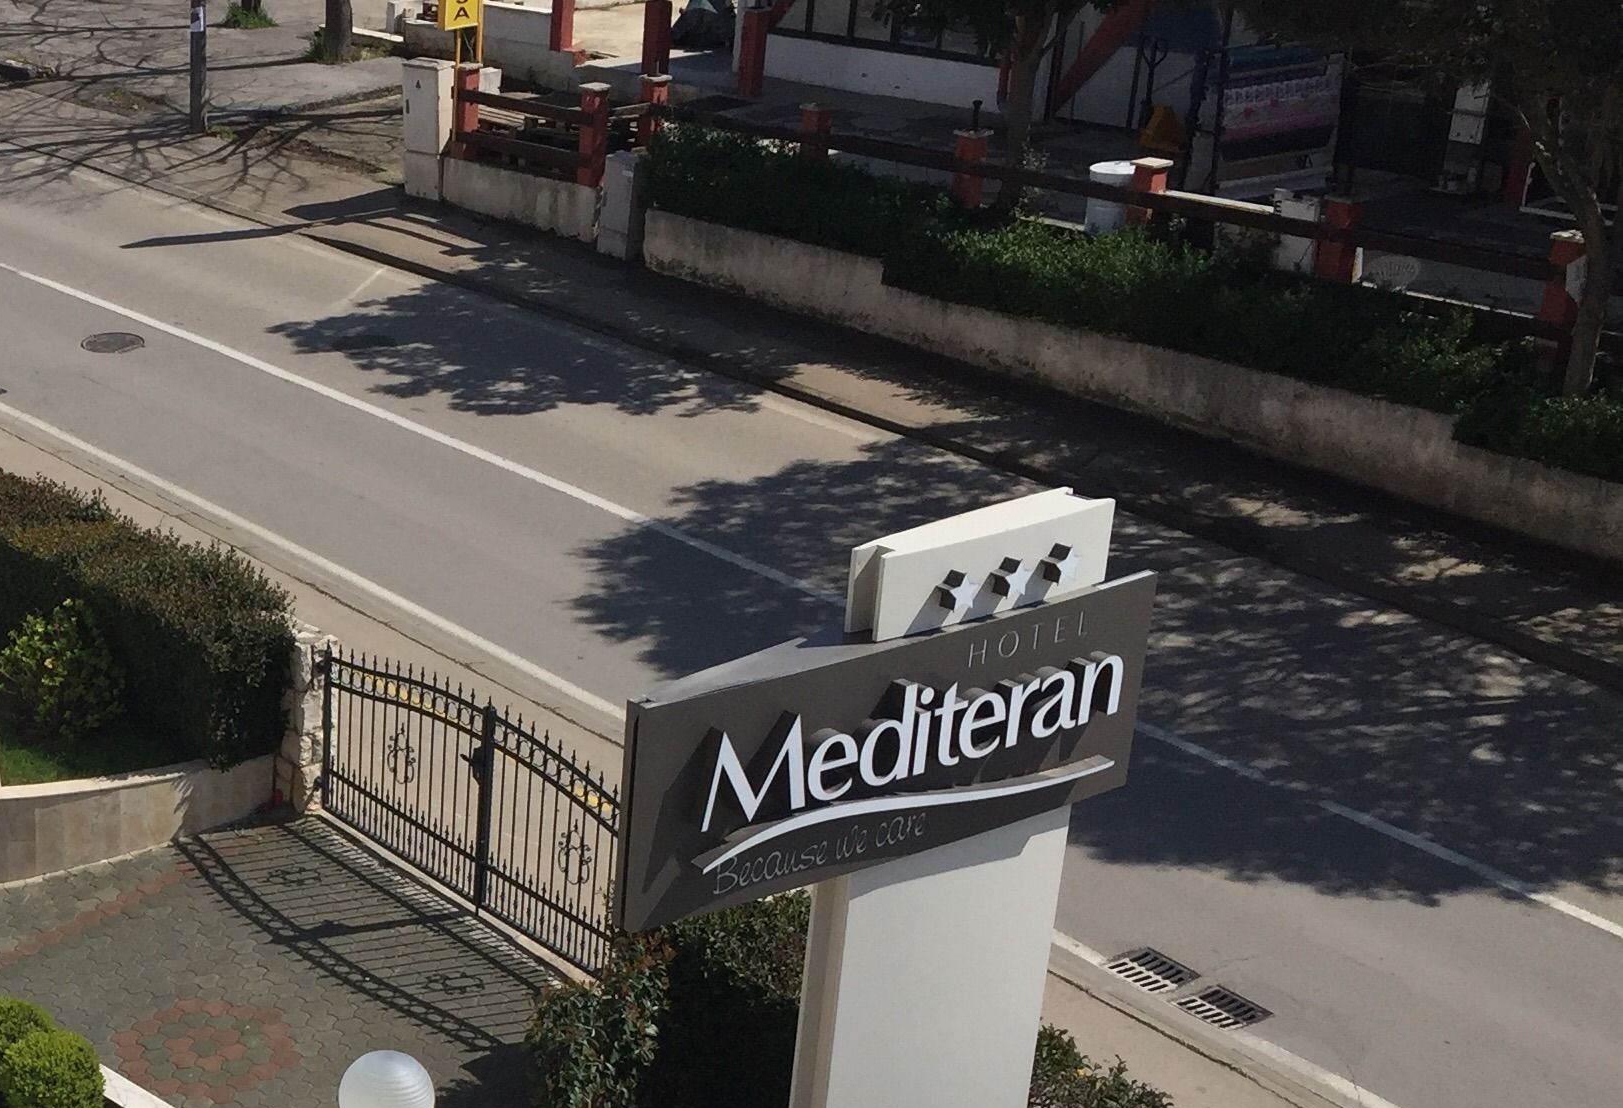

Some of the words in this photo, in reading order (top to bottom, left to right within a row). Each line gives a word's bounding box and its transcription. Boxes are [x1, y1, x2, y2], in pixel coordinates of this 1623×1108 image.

[967, 610, 1088, 669] HOTEL
[700, 655, 1124, 833] Mediteran
[712, 840, 828, 895] Because
[875, 812, 927, 848] care
